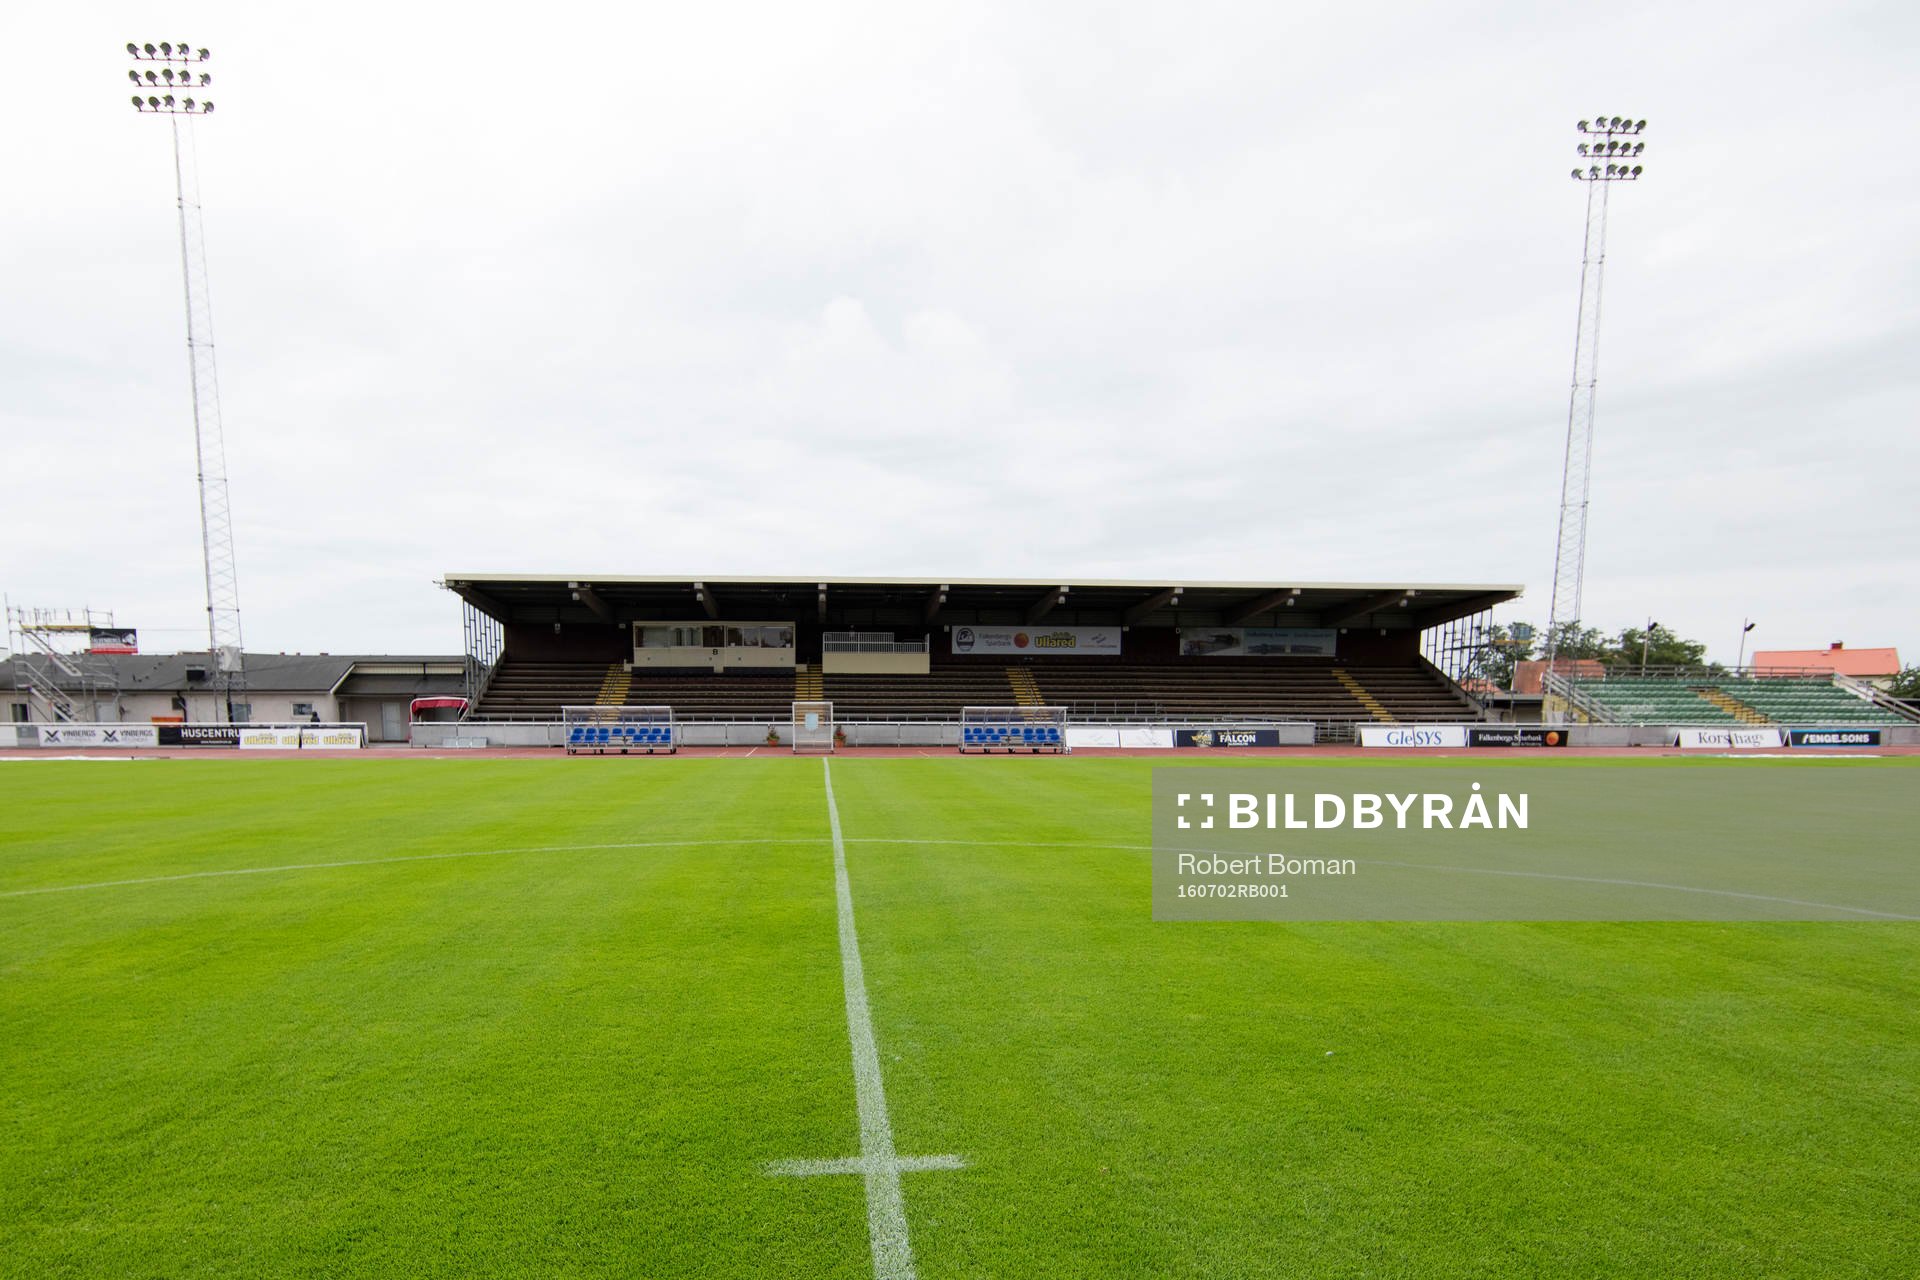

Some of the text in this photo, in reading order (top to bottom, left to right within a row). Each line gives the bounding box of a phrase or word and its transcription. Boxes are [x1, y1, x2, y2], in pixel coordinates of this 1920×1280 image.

[1034, 635, 1076, 648] Ullared
[181, 728, 240, 738] HUSCENTRU
[1386, 731, 1442, 745] GleSYS
[1514, 733, 1542, 742] Sarbank
[1219, 734, 1256, 743] FALCON
